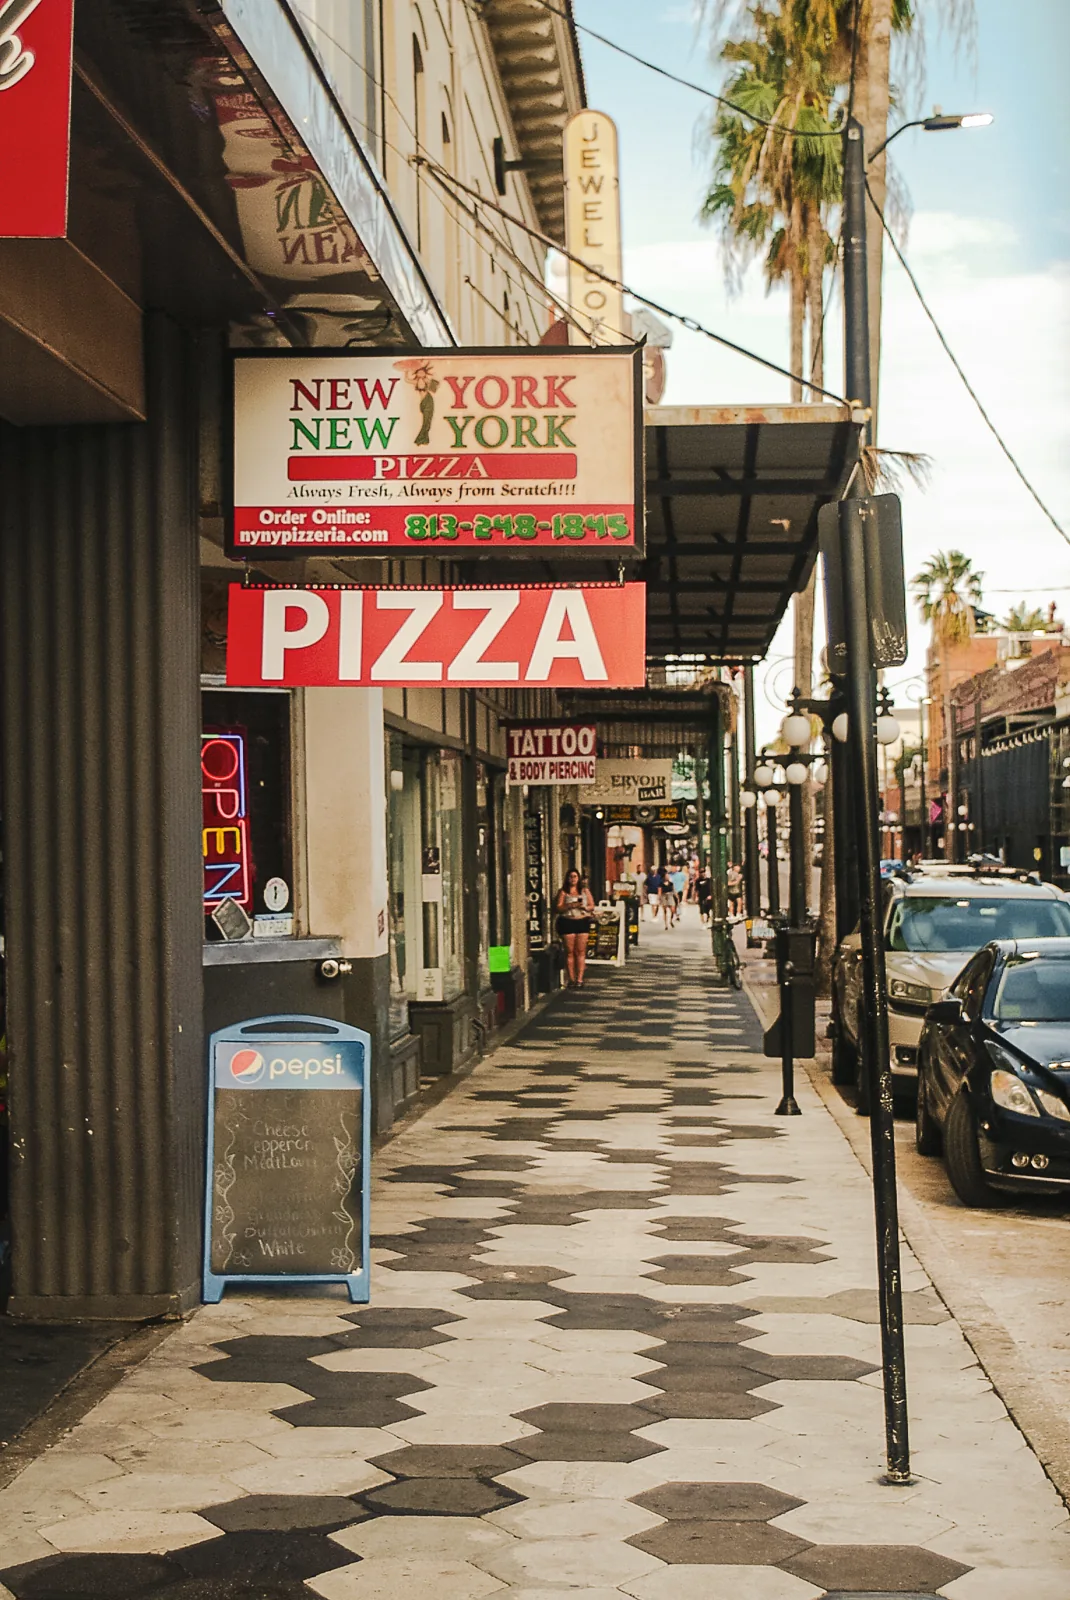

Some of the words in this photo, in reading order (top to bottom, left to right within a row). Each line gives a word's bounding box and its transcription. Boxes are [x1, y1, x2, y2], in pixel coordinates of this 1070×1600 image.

[578, 122, 604, 248] JEWEL
[289, 379, 400, 411] NEW
[444, 375, 577, 409] YORK
[289, 417, 400, 450] NEW
[443, 415, 577, 448] YORK
[372, 456, 490, 480] PIZZA
[287, 484, 342, 503] Always
[348, 483, 393, 499] Fresh,
[397, 482, 452, 502] Always
[455, 482, 495, 502] from
[500, 481, 576, 497] Scratch!!!
[259, 510, 307, 524] Order
[311, 509, 371, 524] Online:
[404, 513, 631, 541] 813-248-1845
[239, 527, 389, 546] nynypizzeria.com
[261, 590, 609, 681] PIZZA
[509, 728, 595, 756] TATTOO
[509, 761, 517, 780] &
[519, 762, 547, 781] BODY
[549, 760, 595, 780] PIERCING
[640, 789, 664, 799] BAR
[200, 739, 243, 899] OPEN
[269, 1053, 343, 1080] pepsi
[252, 1119, 309, 1137] Cheese
[258, 1239, 306, 1257] White
